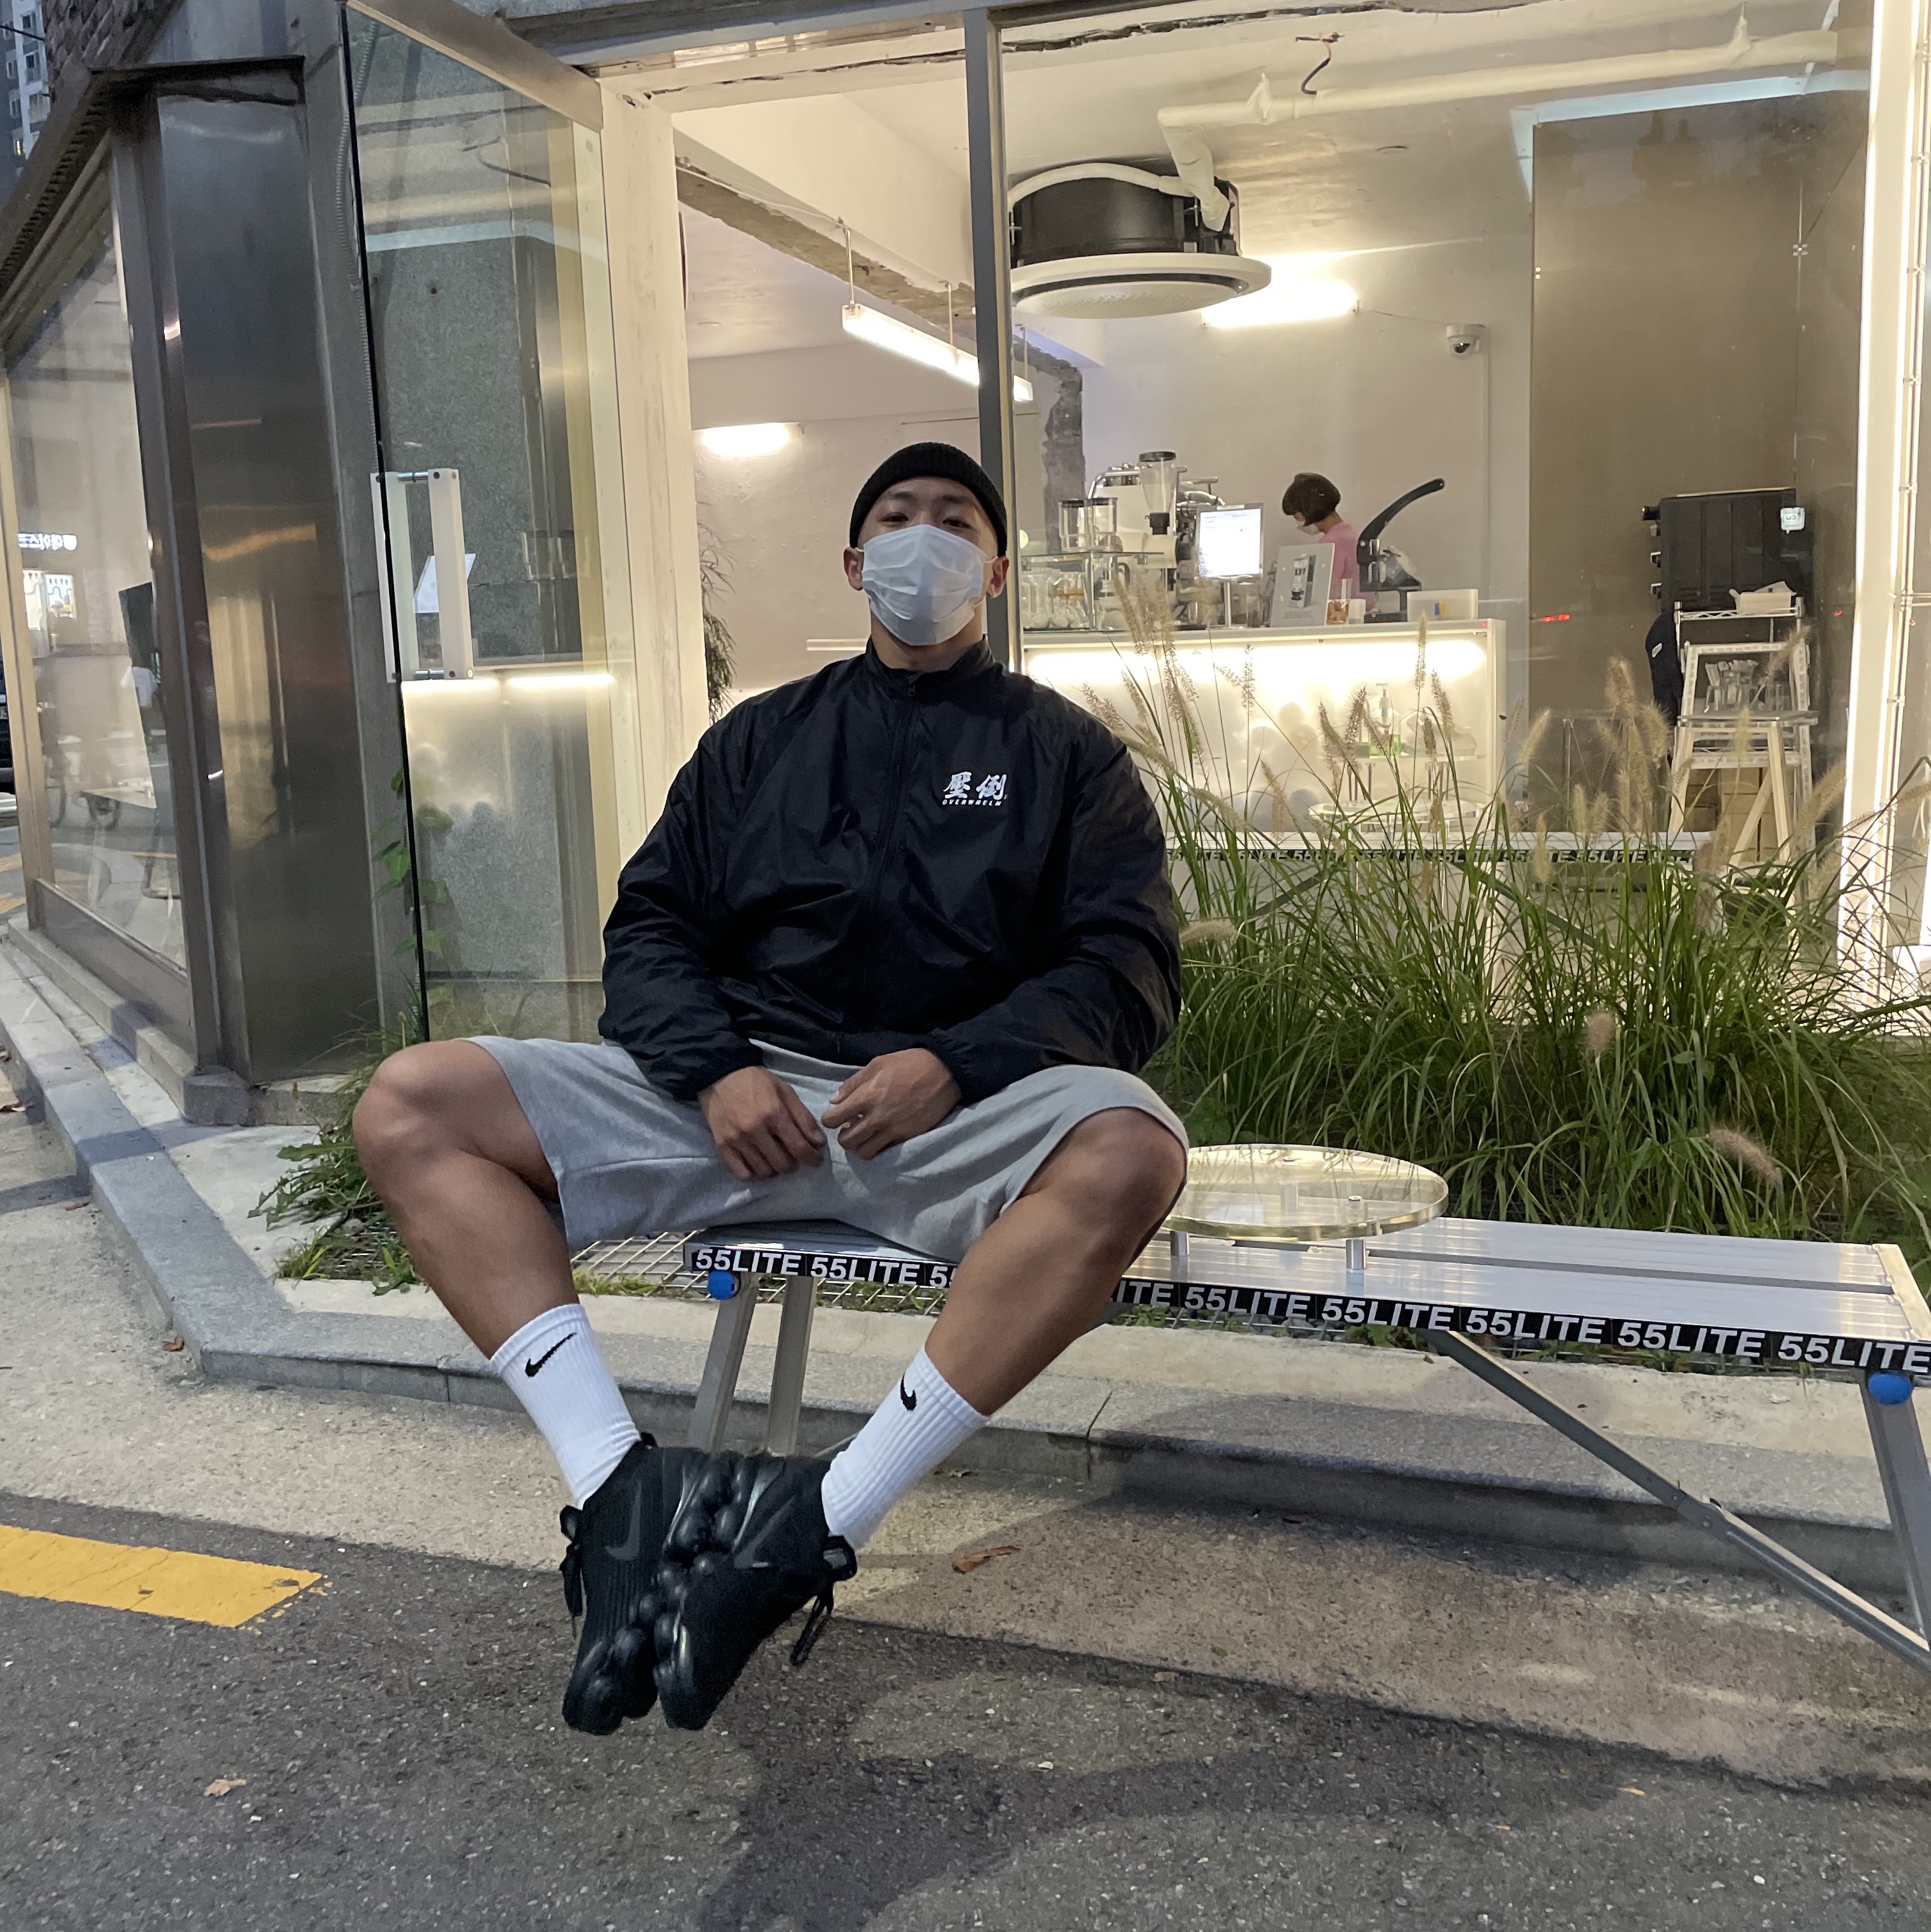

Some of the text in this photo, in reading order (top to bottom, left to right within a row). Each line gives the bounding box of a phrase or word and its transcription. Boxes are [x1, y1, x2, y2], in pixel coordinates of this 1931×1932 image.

[695, 1249, 801, 1275] 55LITE
[810, 1258, 920, 1286] 55LITE
[1111, 1280, 1174, 1307] ITE
[1185, 1286, 1311, 1318] 55LITE
[1322, 1298, 1455, 1330] 55LITE
[1466, 1310, 1606, 1344] 55LITE
[1617, 1322, 1766, 1358] 55LITE
[1778, 1335, 1931, 1373] 55LITE
